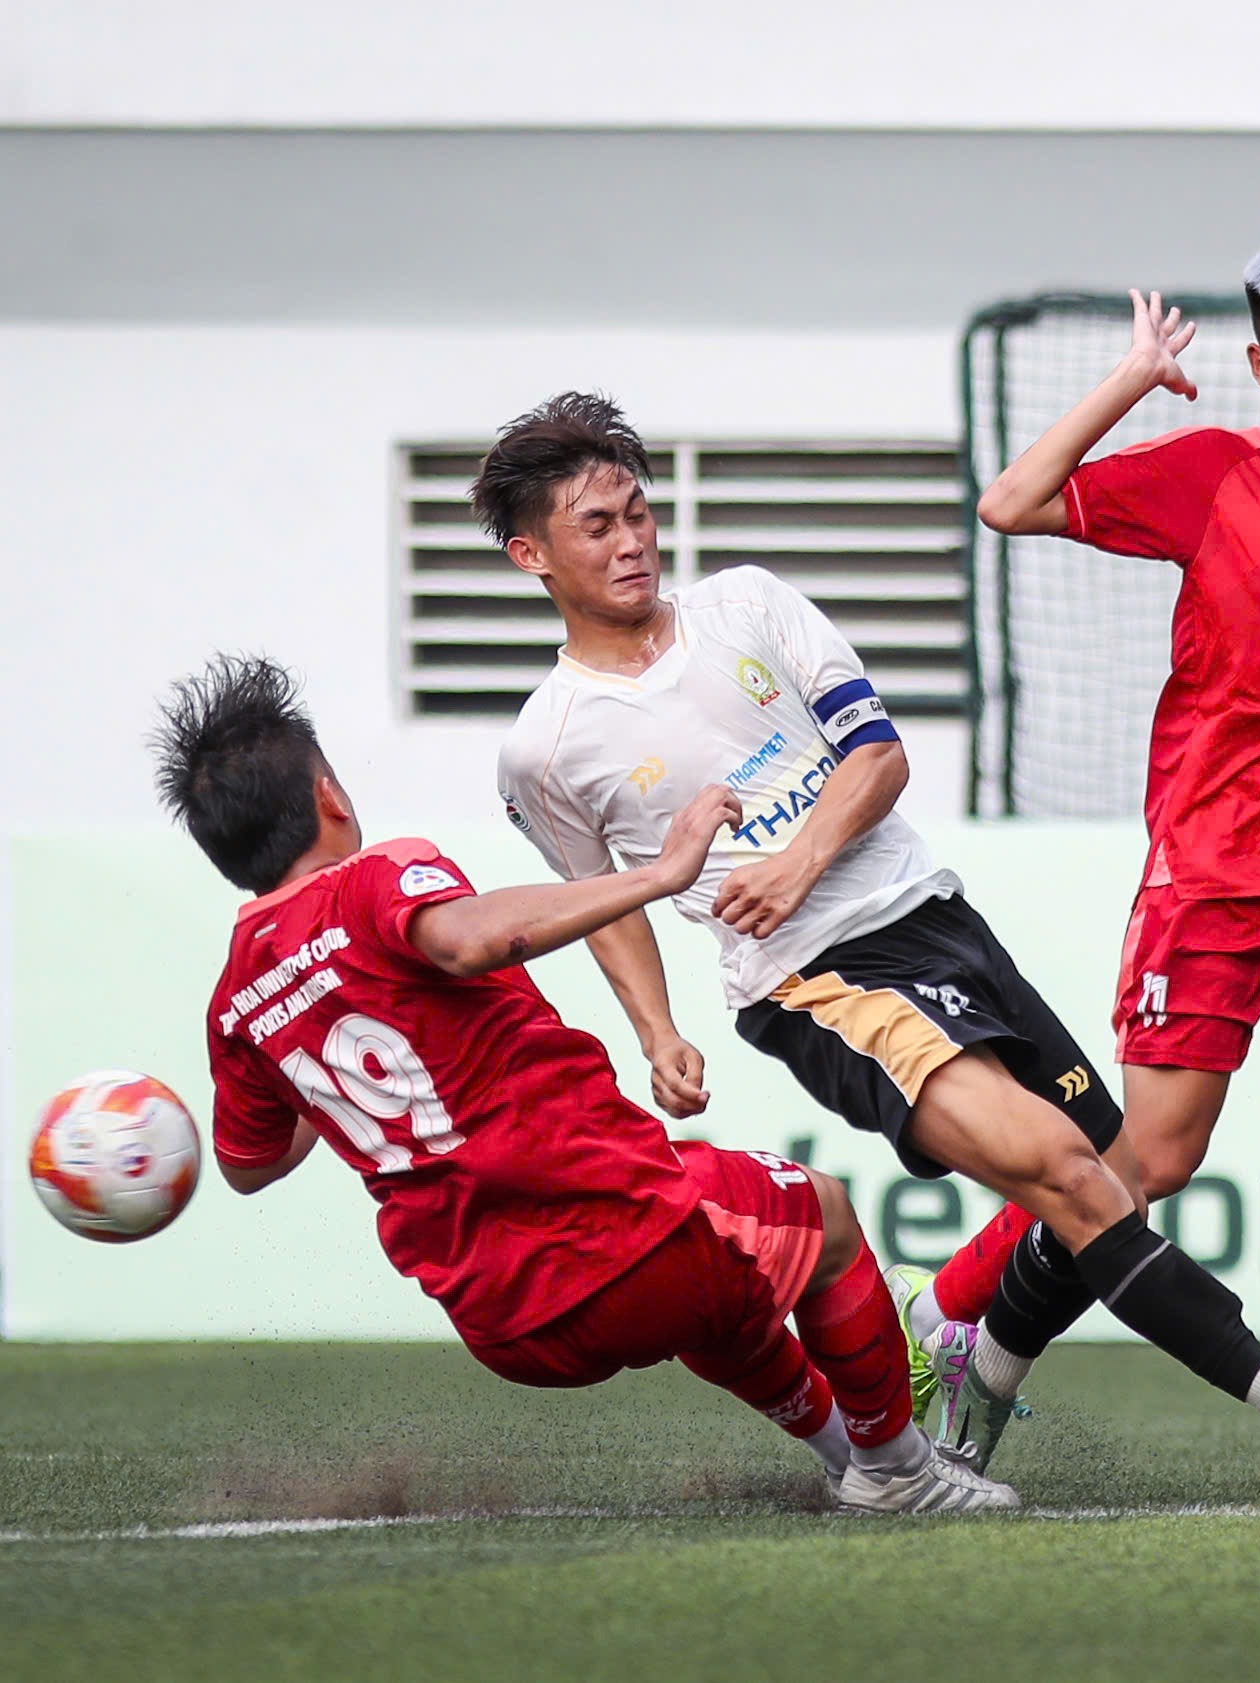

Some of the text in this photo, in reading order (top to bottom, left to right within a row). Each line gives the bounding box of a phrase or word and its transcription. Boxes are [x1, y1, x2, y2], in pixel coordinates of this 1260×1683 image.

[231, 986, 263, 1017] HOA
[248, 1002, 290, 1046] SPORTS
[279, 1046, 467, 1174] 19
